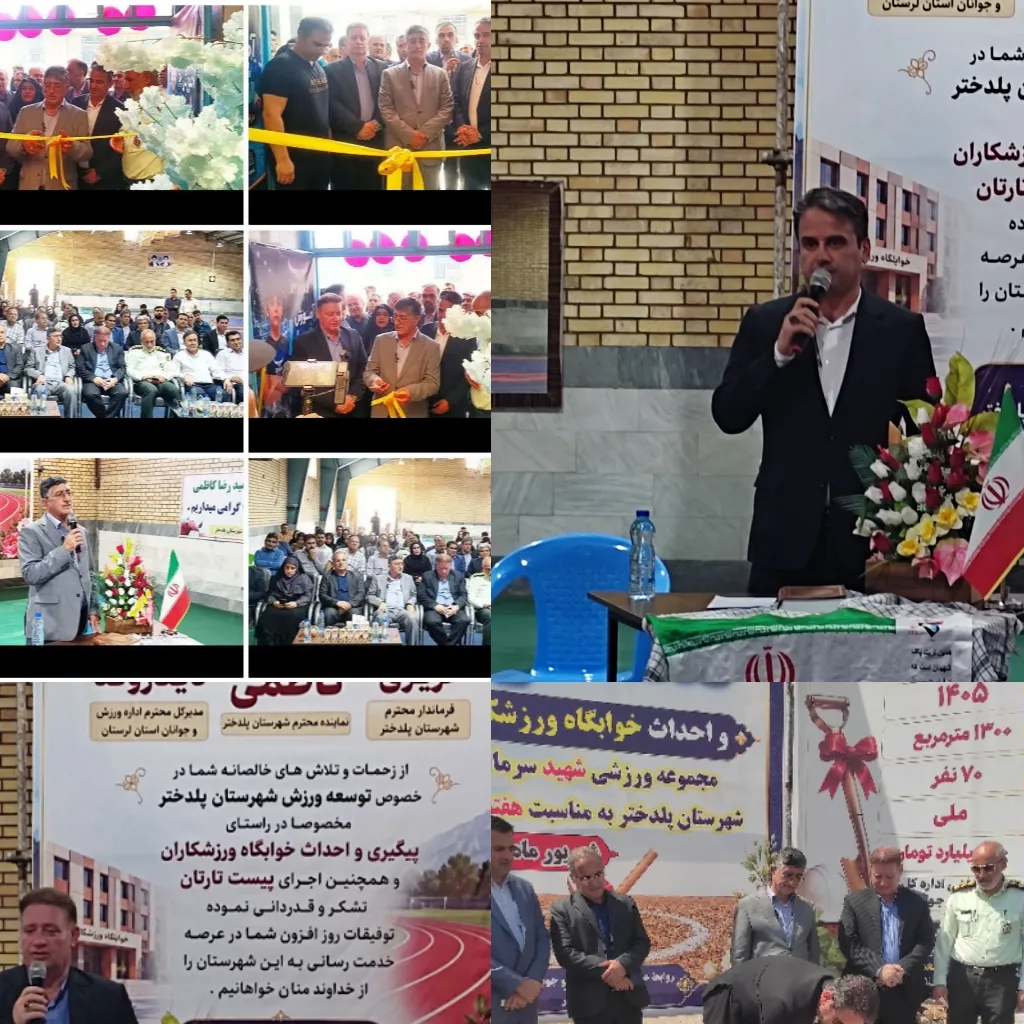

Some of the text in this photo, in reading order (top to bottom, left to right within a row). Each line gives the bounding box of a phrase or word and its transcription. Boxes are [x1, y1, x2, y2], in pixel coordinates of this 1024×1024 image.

[969, 50, 985, 65] در
[990, 46, 1024, 61] شما
[951, 76, 1011, 103] پلدختر
[979, 282, 989, 302] را
[937, 682, 989, 707] ۱۴۰۵
[96, 707, 204, 719] مدیرکل محترم اداره ورزش
[385, 703, 455, 719] فرماندار محترم
[101, 725, 198, 737] و جوانان استان لرستان
[222, 717, 350, 730] نماینده محترم شهرستان پلدختر
[380, 723, 460, 736] شهرستان پلدختر
[564, 707, 642, 742] خوابگاه
[649, 718, 713, 741] احداث
[717, 731, 729, 750] و
[913, 722, 1012, 751] ۱۳۰۰ مترمربع
[542, 759, 586, 781] شهید
[591, 763, 652, 788] ورزشی
[656, 770, 718, 790] مجموعه
[930, 765, 983, 789] ۷۰ نفر
[528, 801, 592, 823] مناسبت
[598, 804, 614, 826] به
[618, 805, 673, 831] پلدختر
[677, 807, 744, 832] شهرستان
[933, 804, 968, 827] ملی
